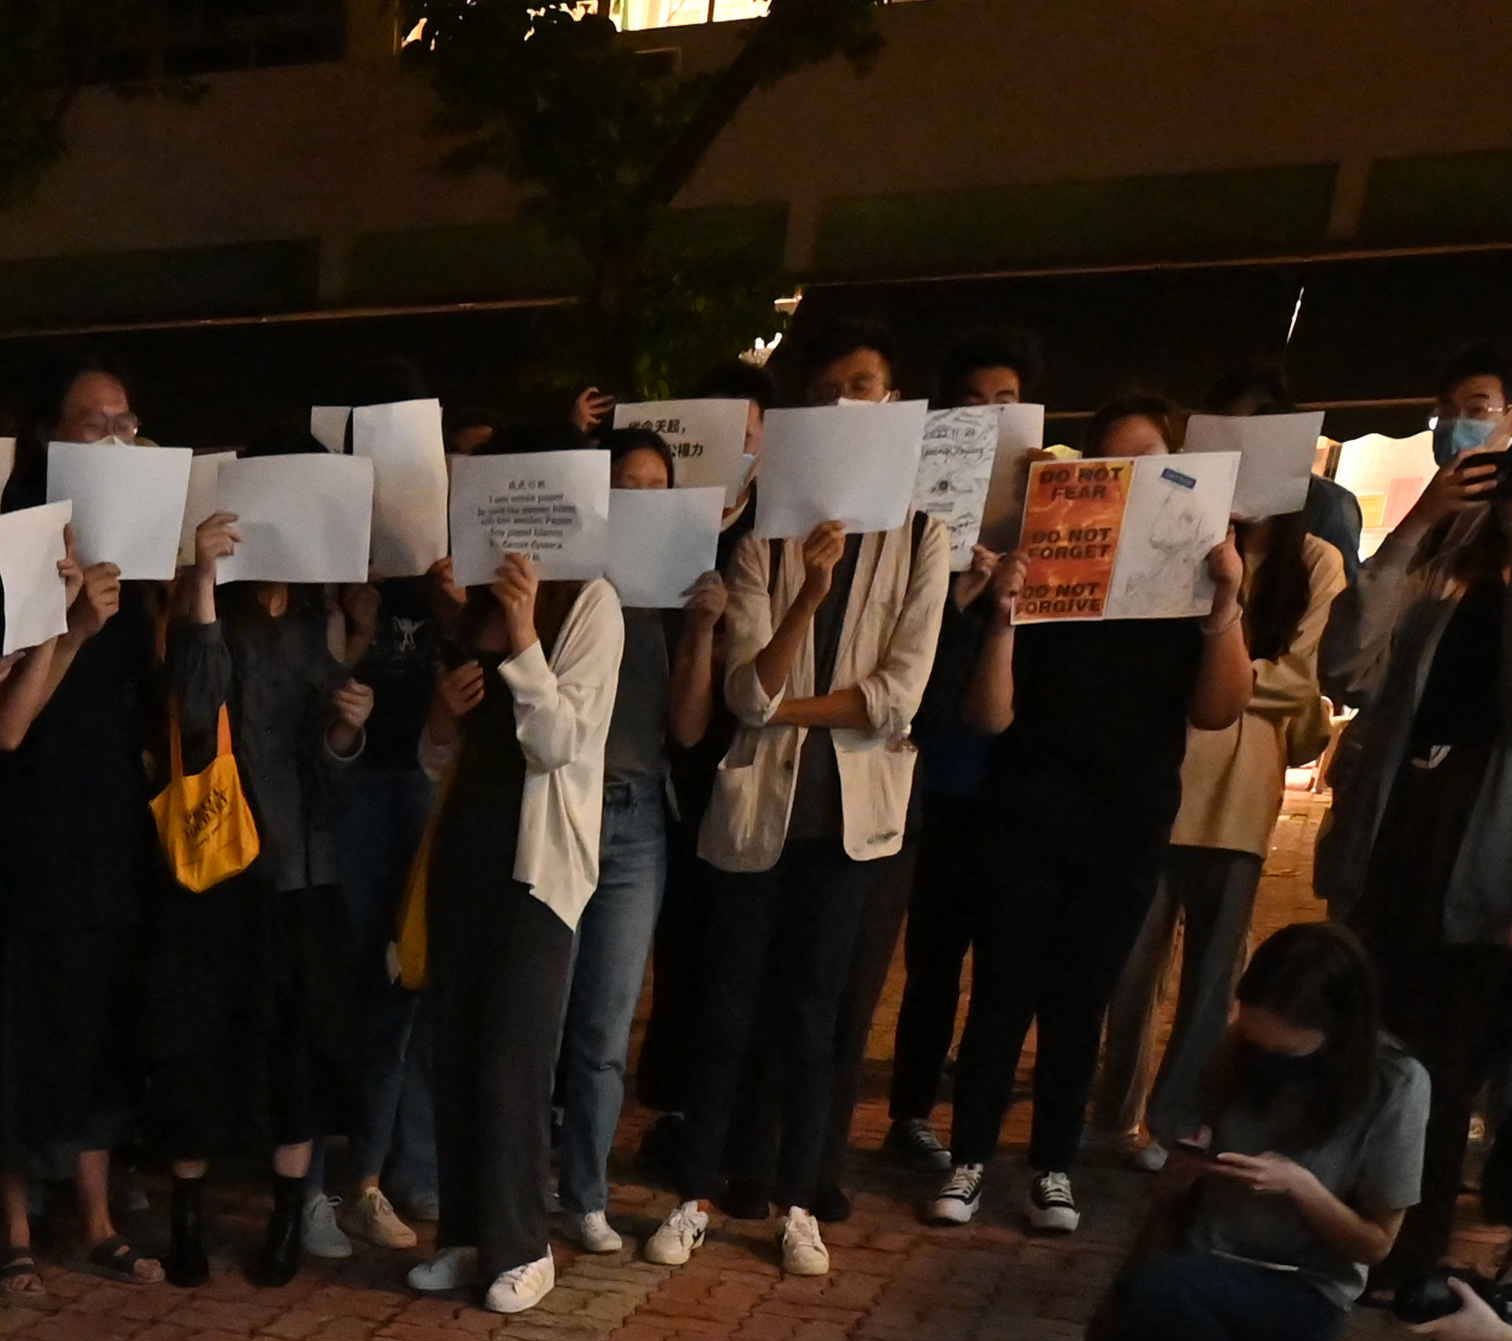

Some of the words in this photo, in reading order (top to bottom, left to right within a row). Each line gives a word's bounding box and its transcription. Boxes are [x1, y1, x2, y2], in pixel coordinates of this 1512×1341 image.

[1040, 469, 1070, 483] DO
[1078, 467, 1124, 482] NOT
[1051, 485, 1108, 500] FEAR
[1032, 529, 1060, 544] DO
[1069, 527, 1113, 542] NOT
[1028, 544, 1112, 560] FORGET
[1022, 584, 1049, 598] DO
[1056, 582, 1101, 598] NOT
[1015, 598, 1103, 615] FORGIVE
